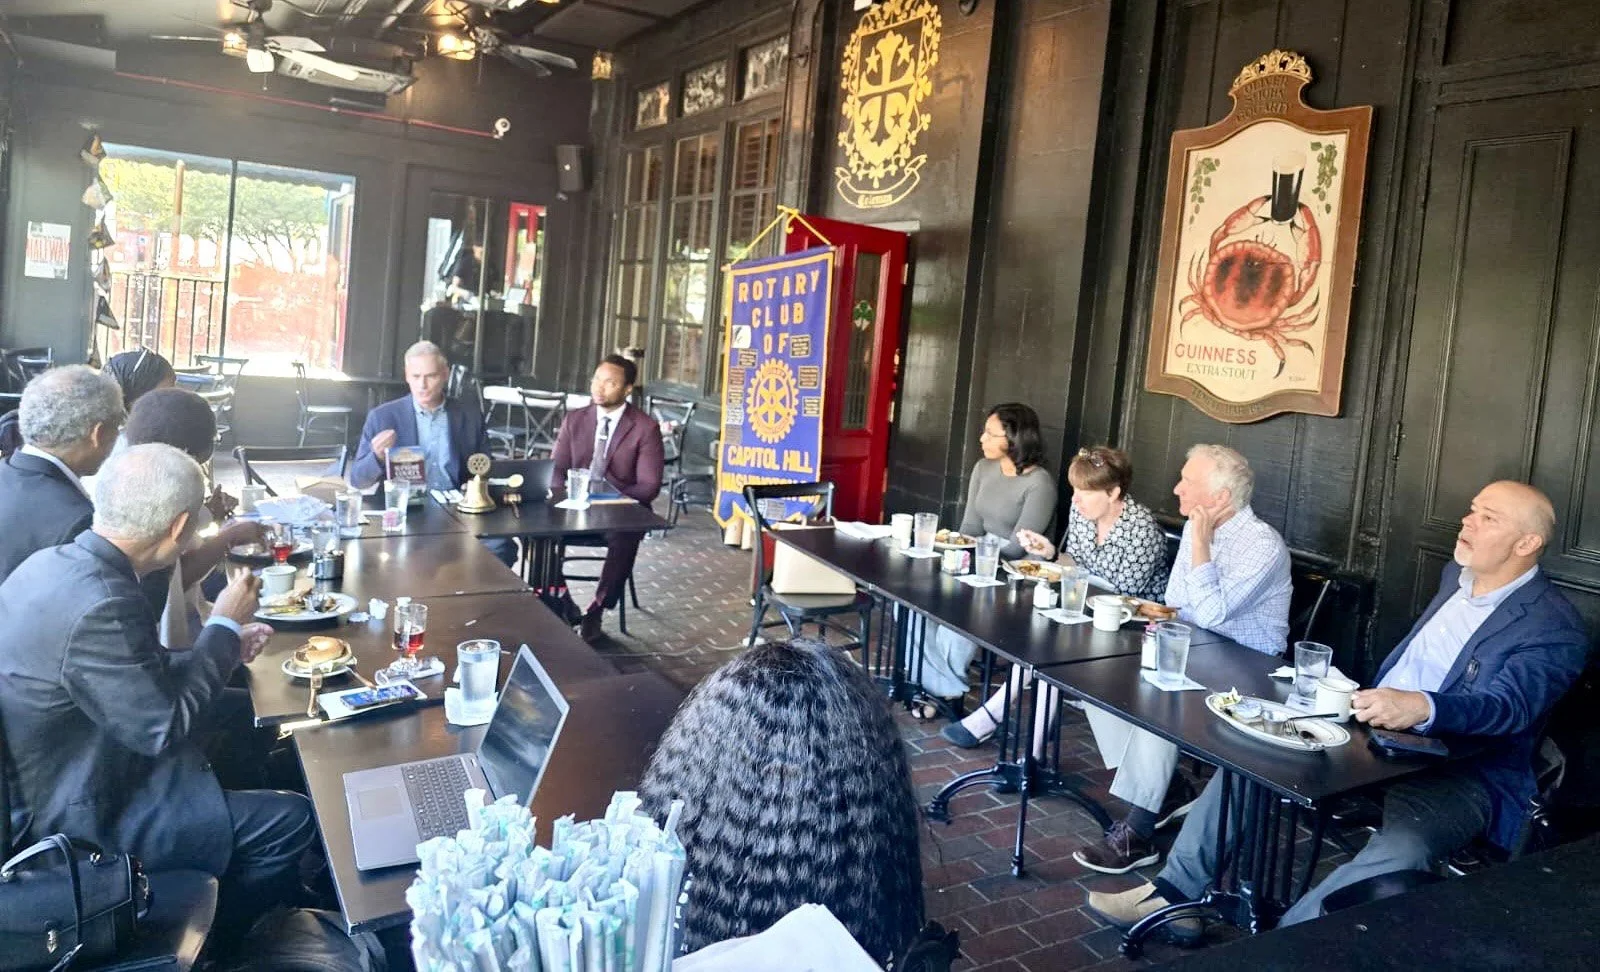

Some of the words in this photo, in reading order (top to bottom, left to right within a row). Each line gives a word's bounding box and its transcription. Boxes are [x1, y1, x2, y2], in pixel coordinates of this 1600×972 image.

[738, 270, 820, 302] ROTARY
[752, 302, 804, 328] CLUB
[763, 332, 790, 354] OF
[1174, 343, 1257, 365] GUINNESS
[728, 445, 780, 470] CAPITOL
[783, 449, 813, 473] HILL
